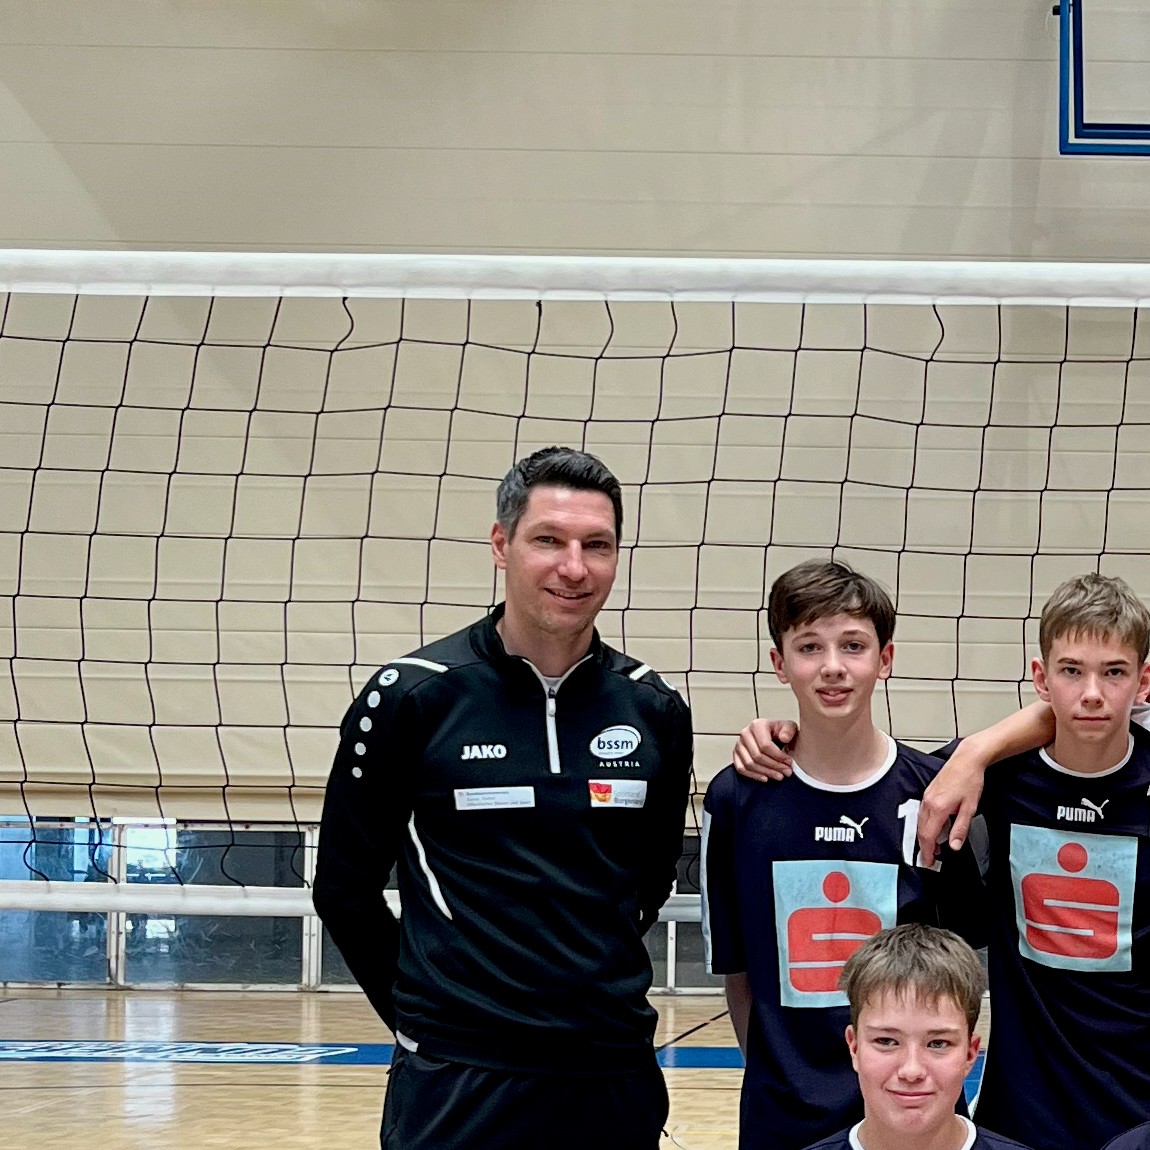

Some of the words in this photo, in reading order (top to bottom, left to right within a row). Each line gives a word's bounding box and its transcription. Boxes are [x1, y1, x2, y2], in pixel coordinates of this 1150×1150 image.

[597, 736, 634, 750] bssm
[461, 744, 507, 760] JAKO
[599, 760, 640, 768] AUSTRIA
[1057, 806, 1097, 823] PUMA
[815, 826, 855, 842] PUMA
